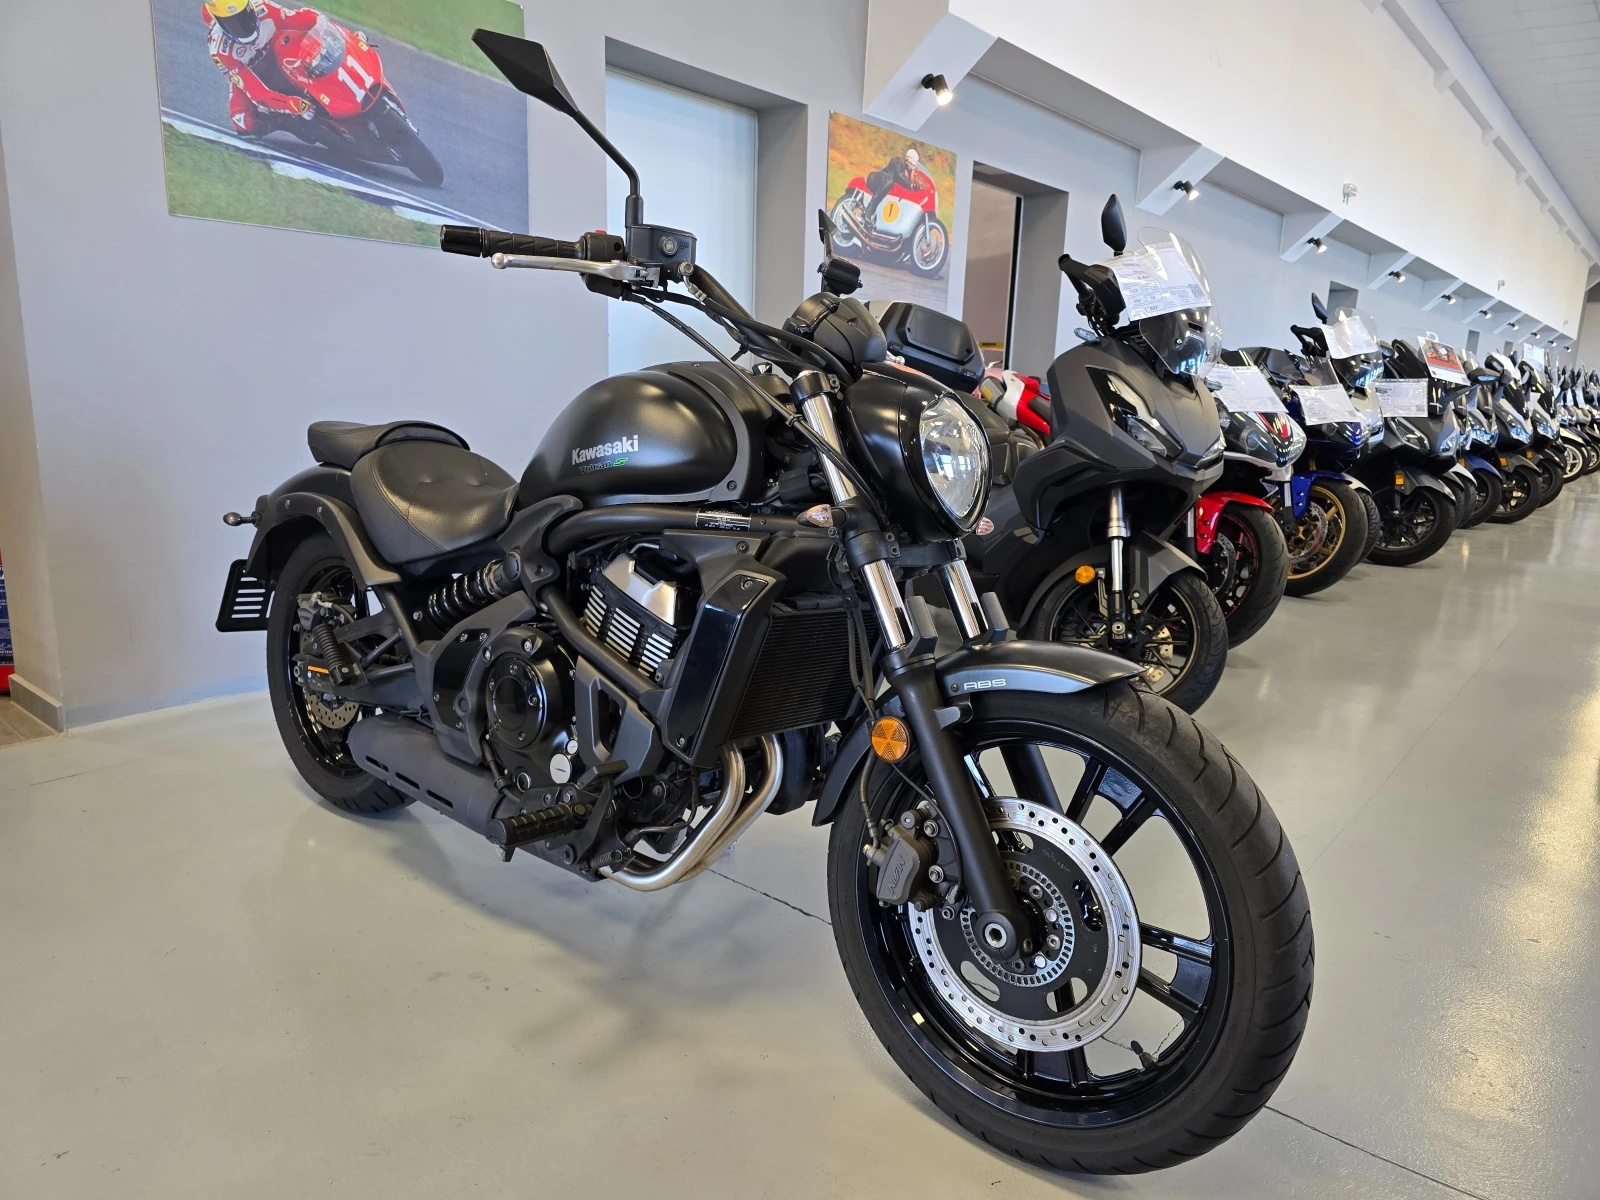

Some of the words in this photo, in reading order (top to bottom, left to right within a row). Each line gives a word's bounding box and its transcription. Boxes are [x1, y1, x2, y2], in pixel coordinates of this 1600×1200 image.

[338, 54, 375, 104] 11
[571, 434, 639, 466] Kawasaki
[963, 678, 1007, 691] ABS
